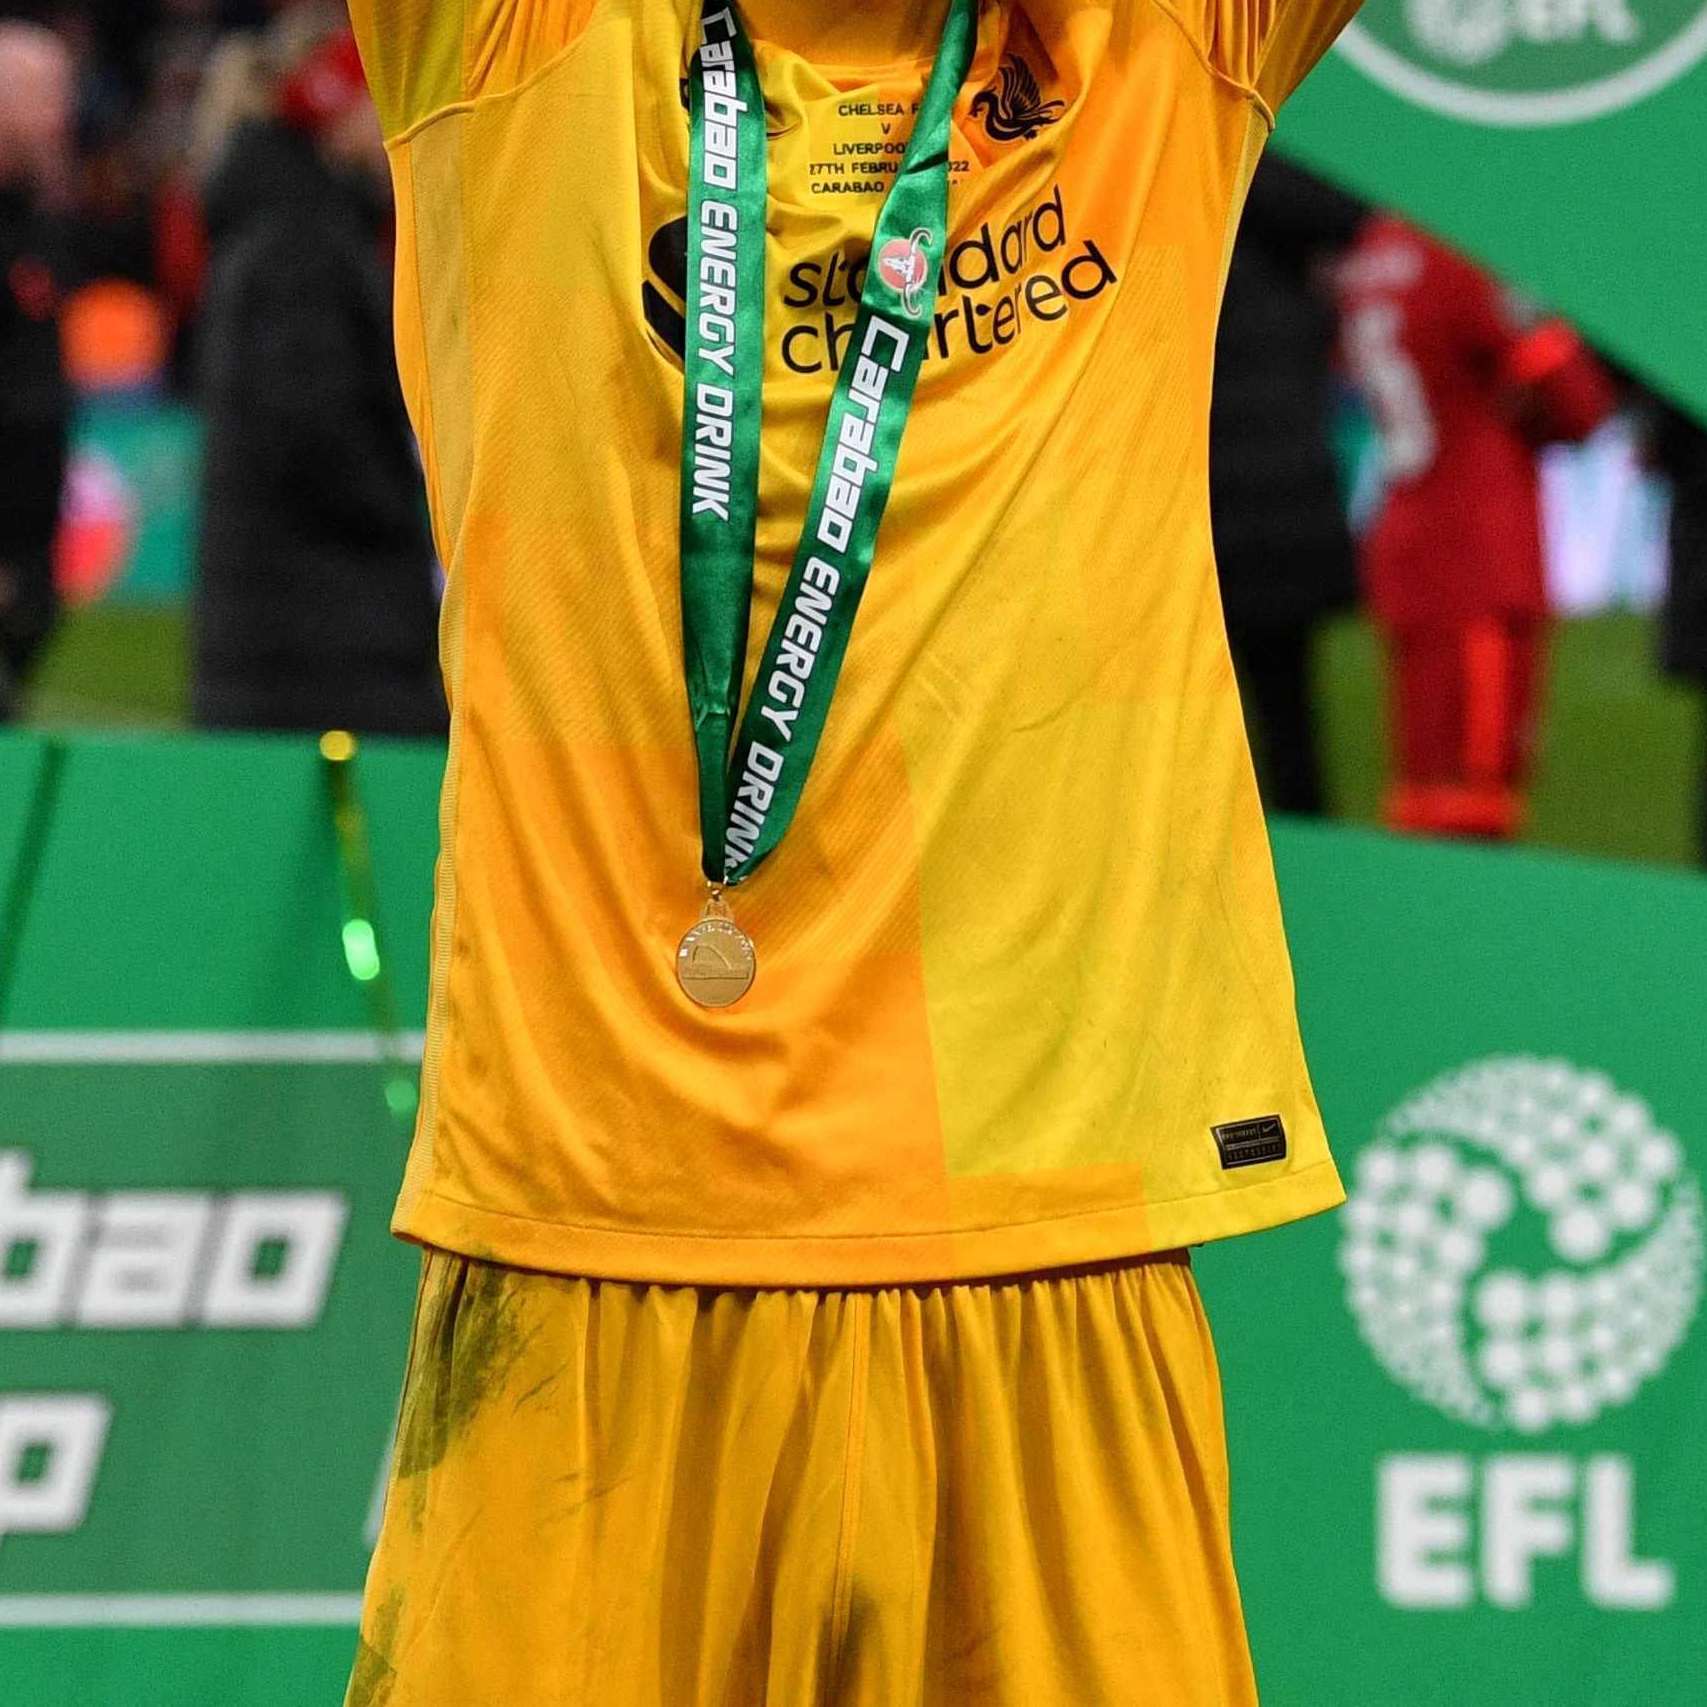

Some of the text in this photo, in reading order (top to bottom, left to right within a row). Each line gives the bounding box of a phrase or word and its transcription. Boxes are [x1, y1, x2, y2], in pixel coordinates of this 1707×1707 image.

[838, 103, 904, 117] CHELSEA
[881, 122, 892, 135] V
[809, 162, 845, 176] 27TH
[851, 161, 899, 175] FEBRU
[833, 142, 907, 156] LIVERPOO
[810, 180, 885, 195] CARABAO
[691, 5, 748, 521] Carabao ENERGY DRINK
[781, 239, 1118, 374] chrtered
[816, 315, 910, 554] Carabao
[761, 555, 840, 742] ENERGY
[1375, 1452, 1675, 1611] EFL
